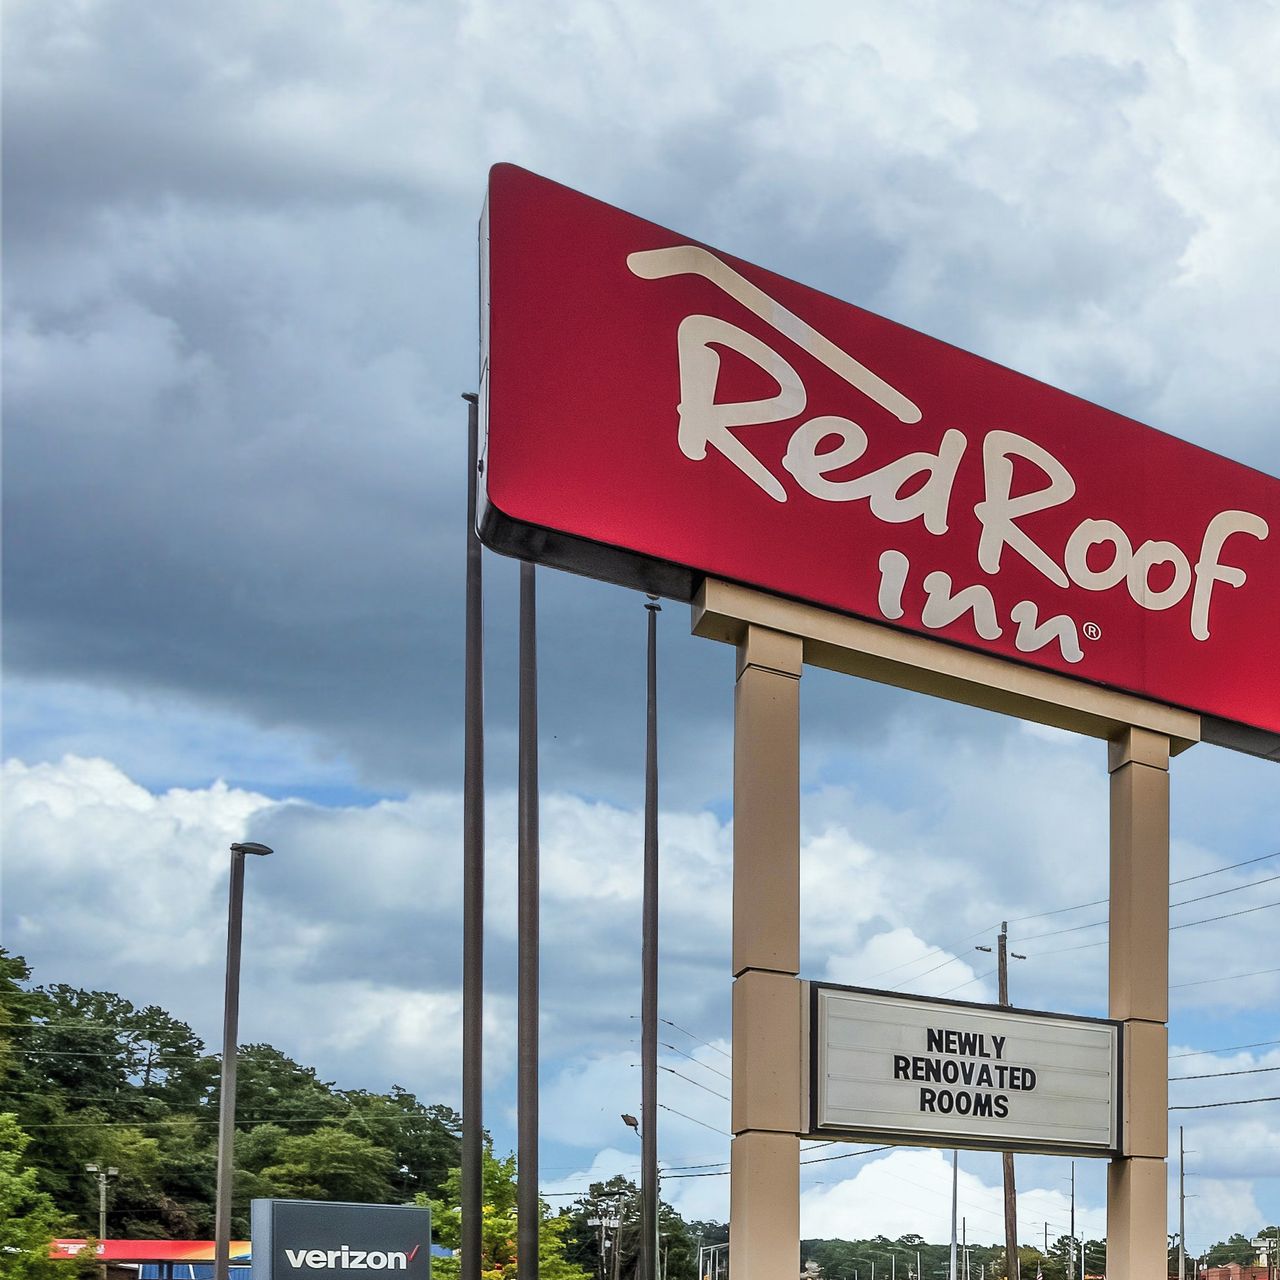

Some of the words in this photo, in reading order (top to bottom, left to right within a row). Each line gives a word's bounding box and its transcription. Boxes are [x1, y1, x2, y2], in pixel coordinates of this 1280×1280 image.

[676, 314, 968, 536] Red
[973, 429, 1270, 642] Roof
[926, 1028, 1006, 1059] NEWLY
[893, 1055, 1037, 1091] RENOVATED
[919, 1088, 1009, 1118] ROOMS
[284, 1245, 407, 1270] verizon
